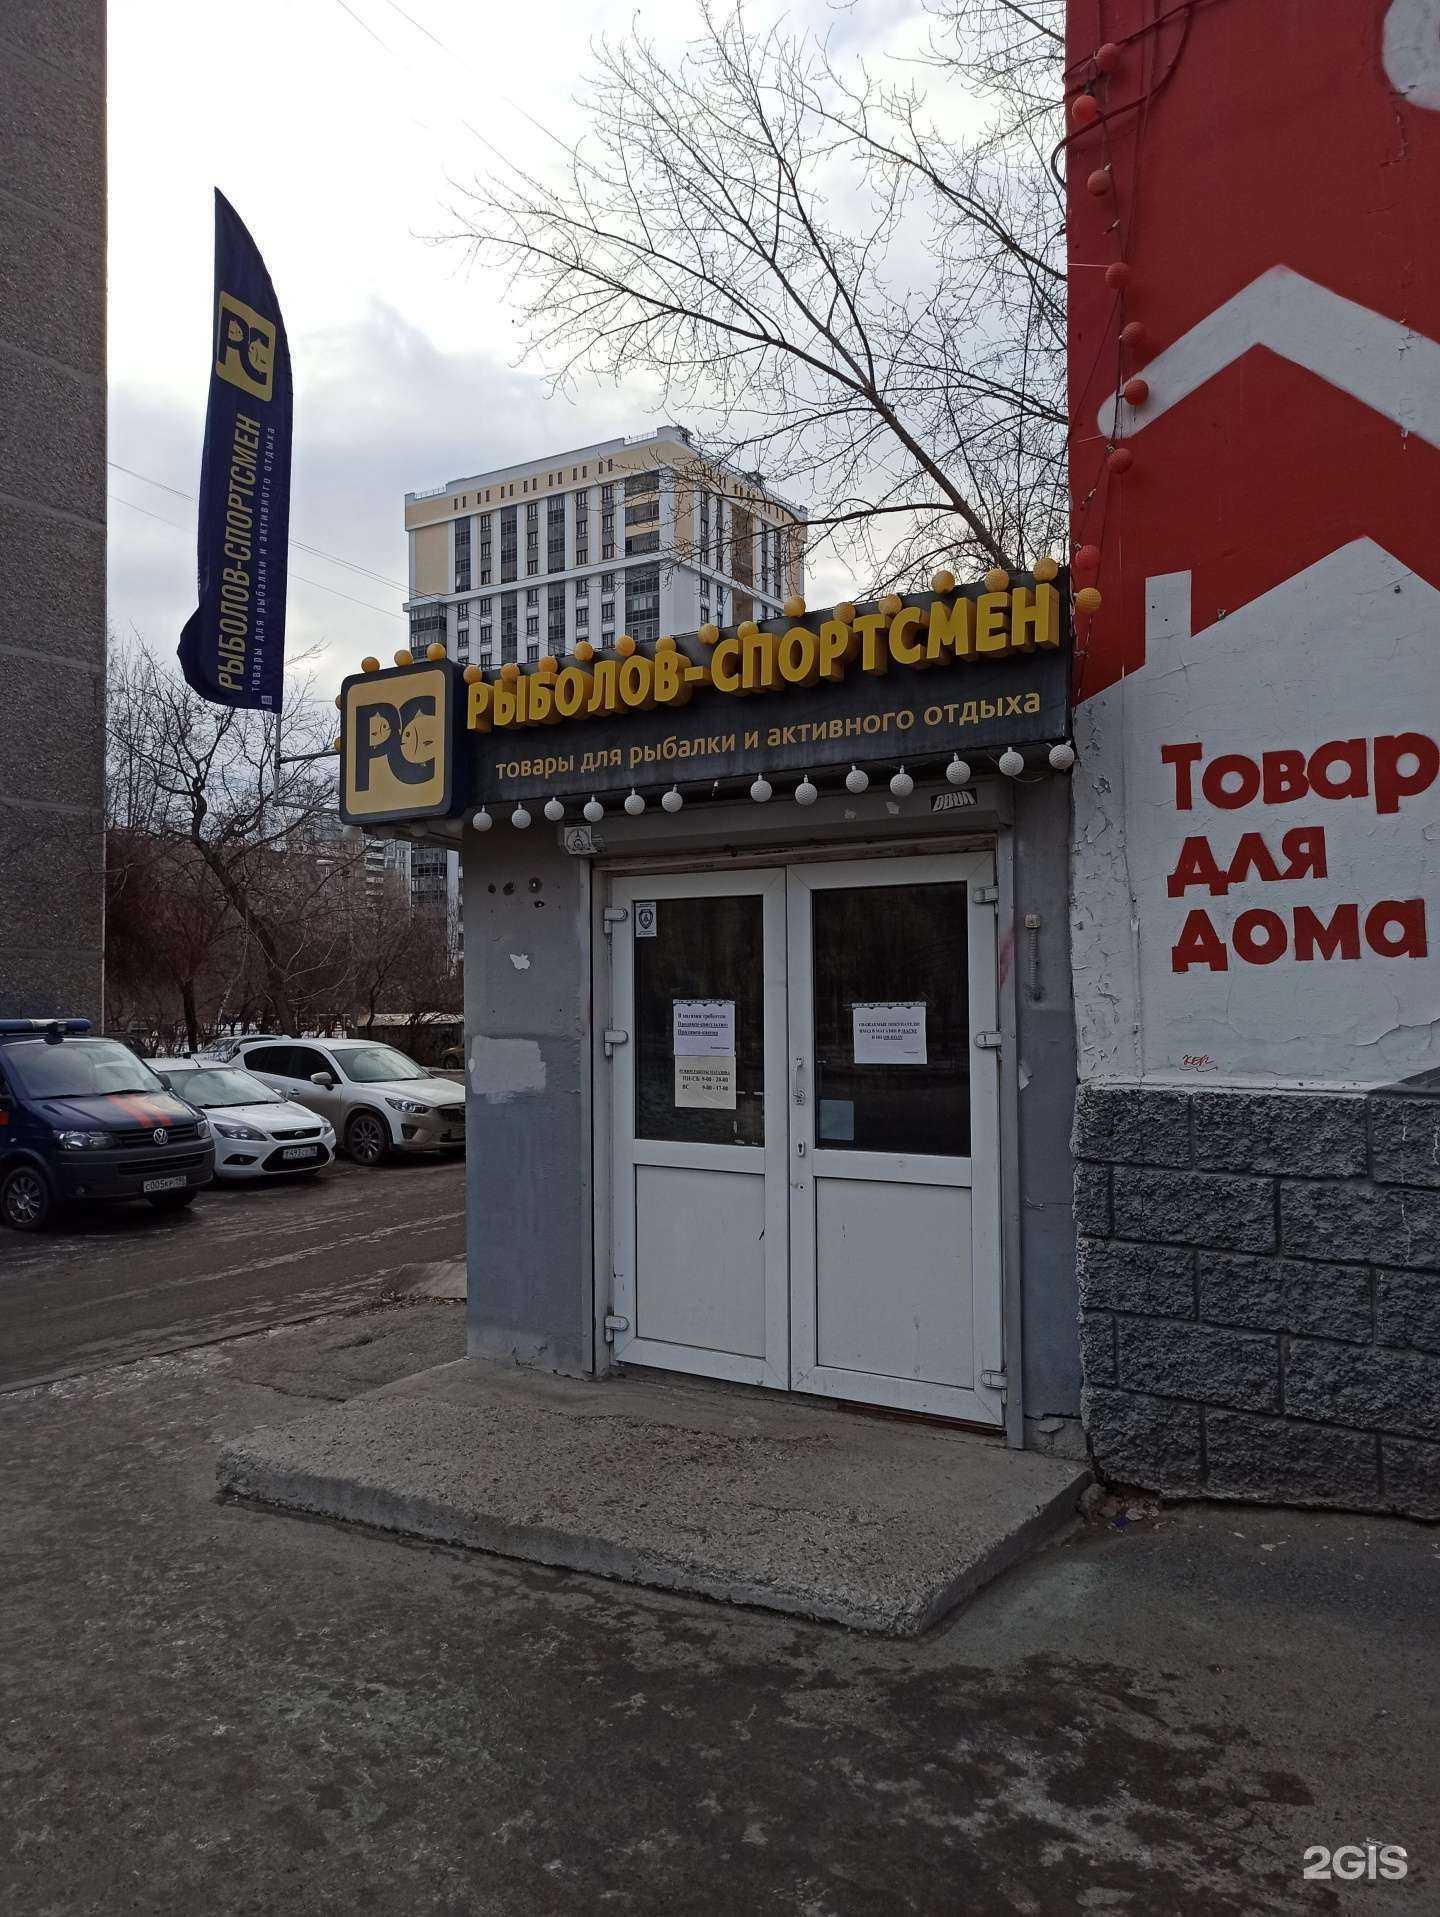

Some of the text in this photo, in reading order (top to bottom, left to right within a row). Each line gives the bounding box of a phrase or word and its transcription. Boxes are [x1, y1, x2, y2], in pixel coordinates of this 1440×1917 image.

[263, 427, 275, 472] отдыха
[259, 478, 272, 542] активного
[218, 413, 261, 691] РЫБОЛОВ-СПОРТСМЕН
[255, 560, 267, 614] рыбалки
[255, 619, 265, 641] для
[466, 582, 1060, 732] РЫБОЛОВ-СПОРТСМЕН
[251, 648, 263, 691] товары
[496, 692, 1041, 780] товары для рыбалки и активного отдыха
[1161, 732, 1439, 814] Товар
